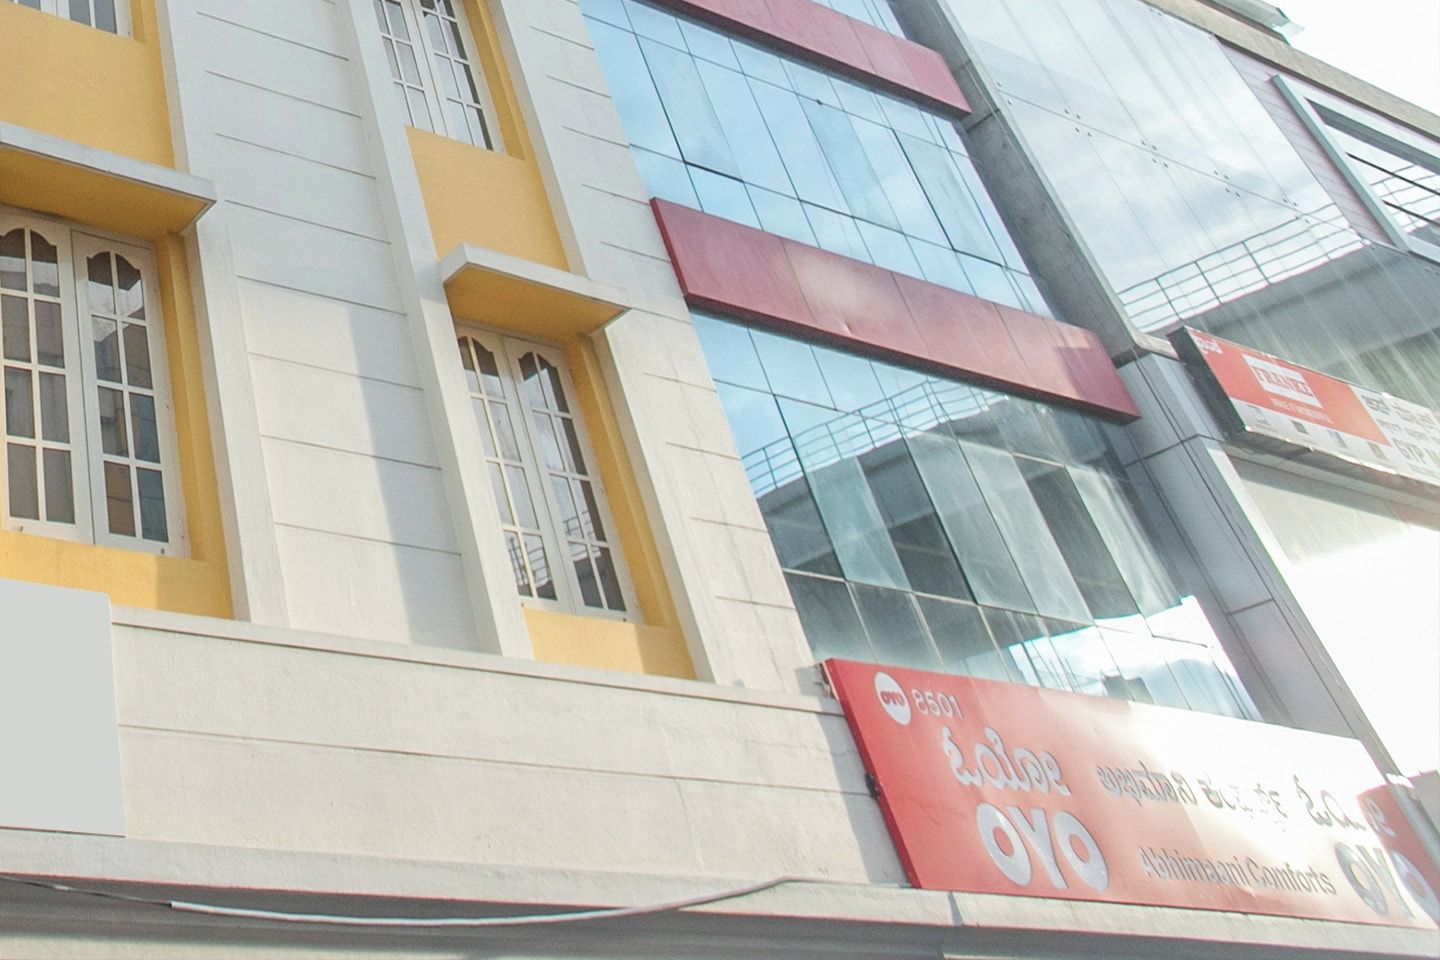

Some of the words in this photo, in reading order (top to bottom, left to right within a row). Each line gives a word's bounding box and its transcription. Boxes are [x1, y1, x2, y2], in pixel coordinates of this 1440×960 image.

[912, 689, 964, 719] 8501
[942, 726, 1072, 796] ಓಯೋ
[976, 802, 1109, 891] OYO
[1138, 846, 1250, 886] Abhimaani
[1245, 856, 1336, 895] Comforts
[1334, 842, 1440, 921] OYO
